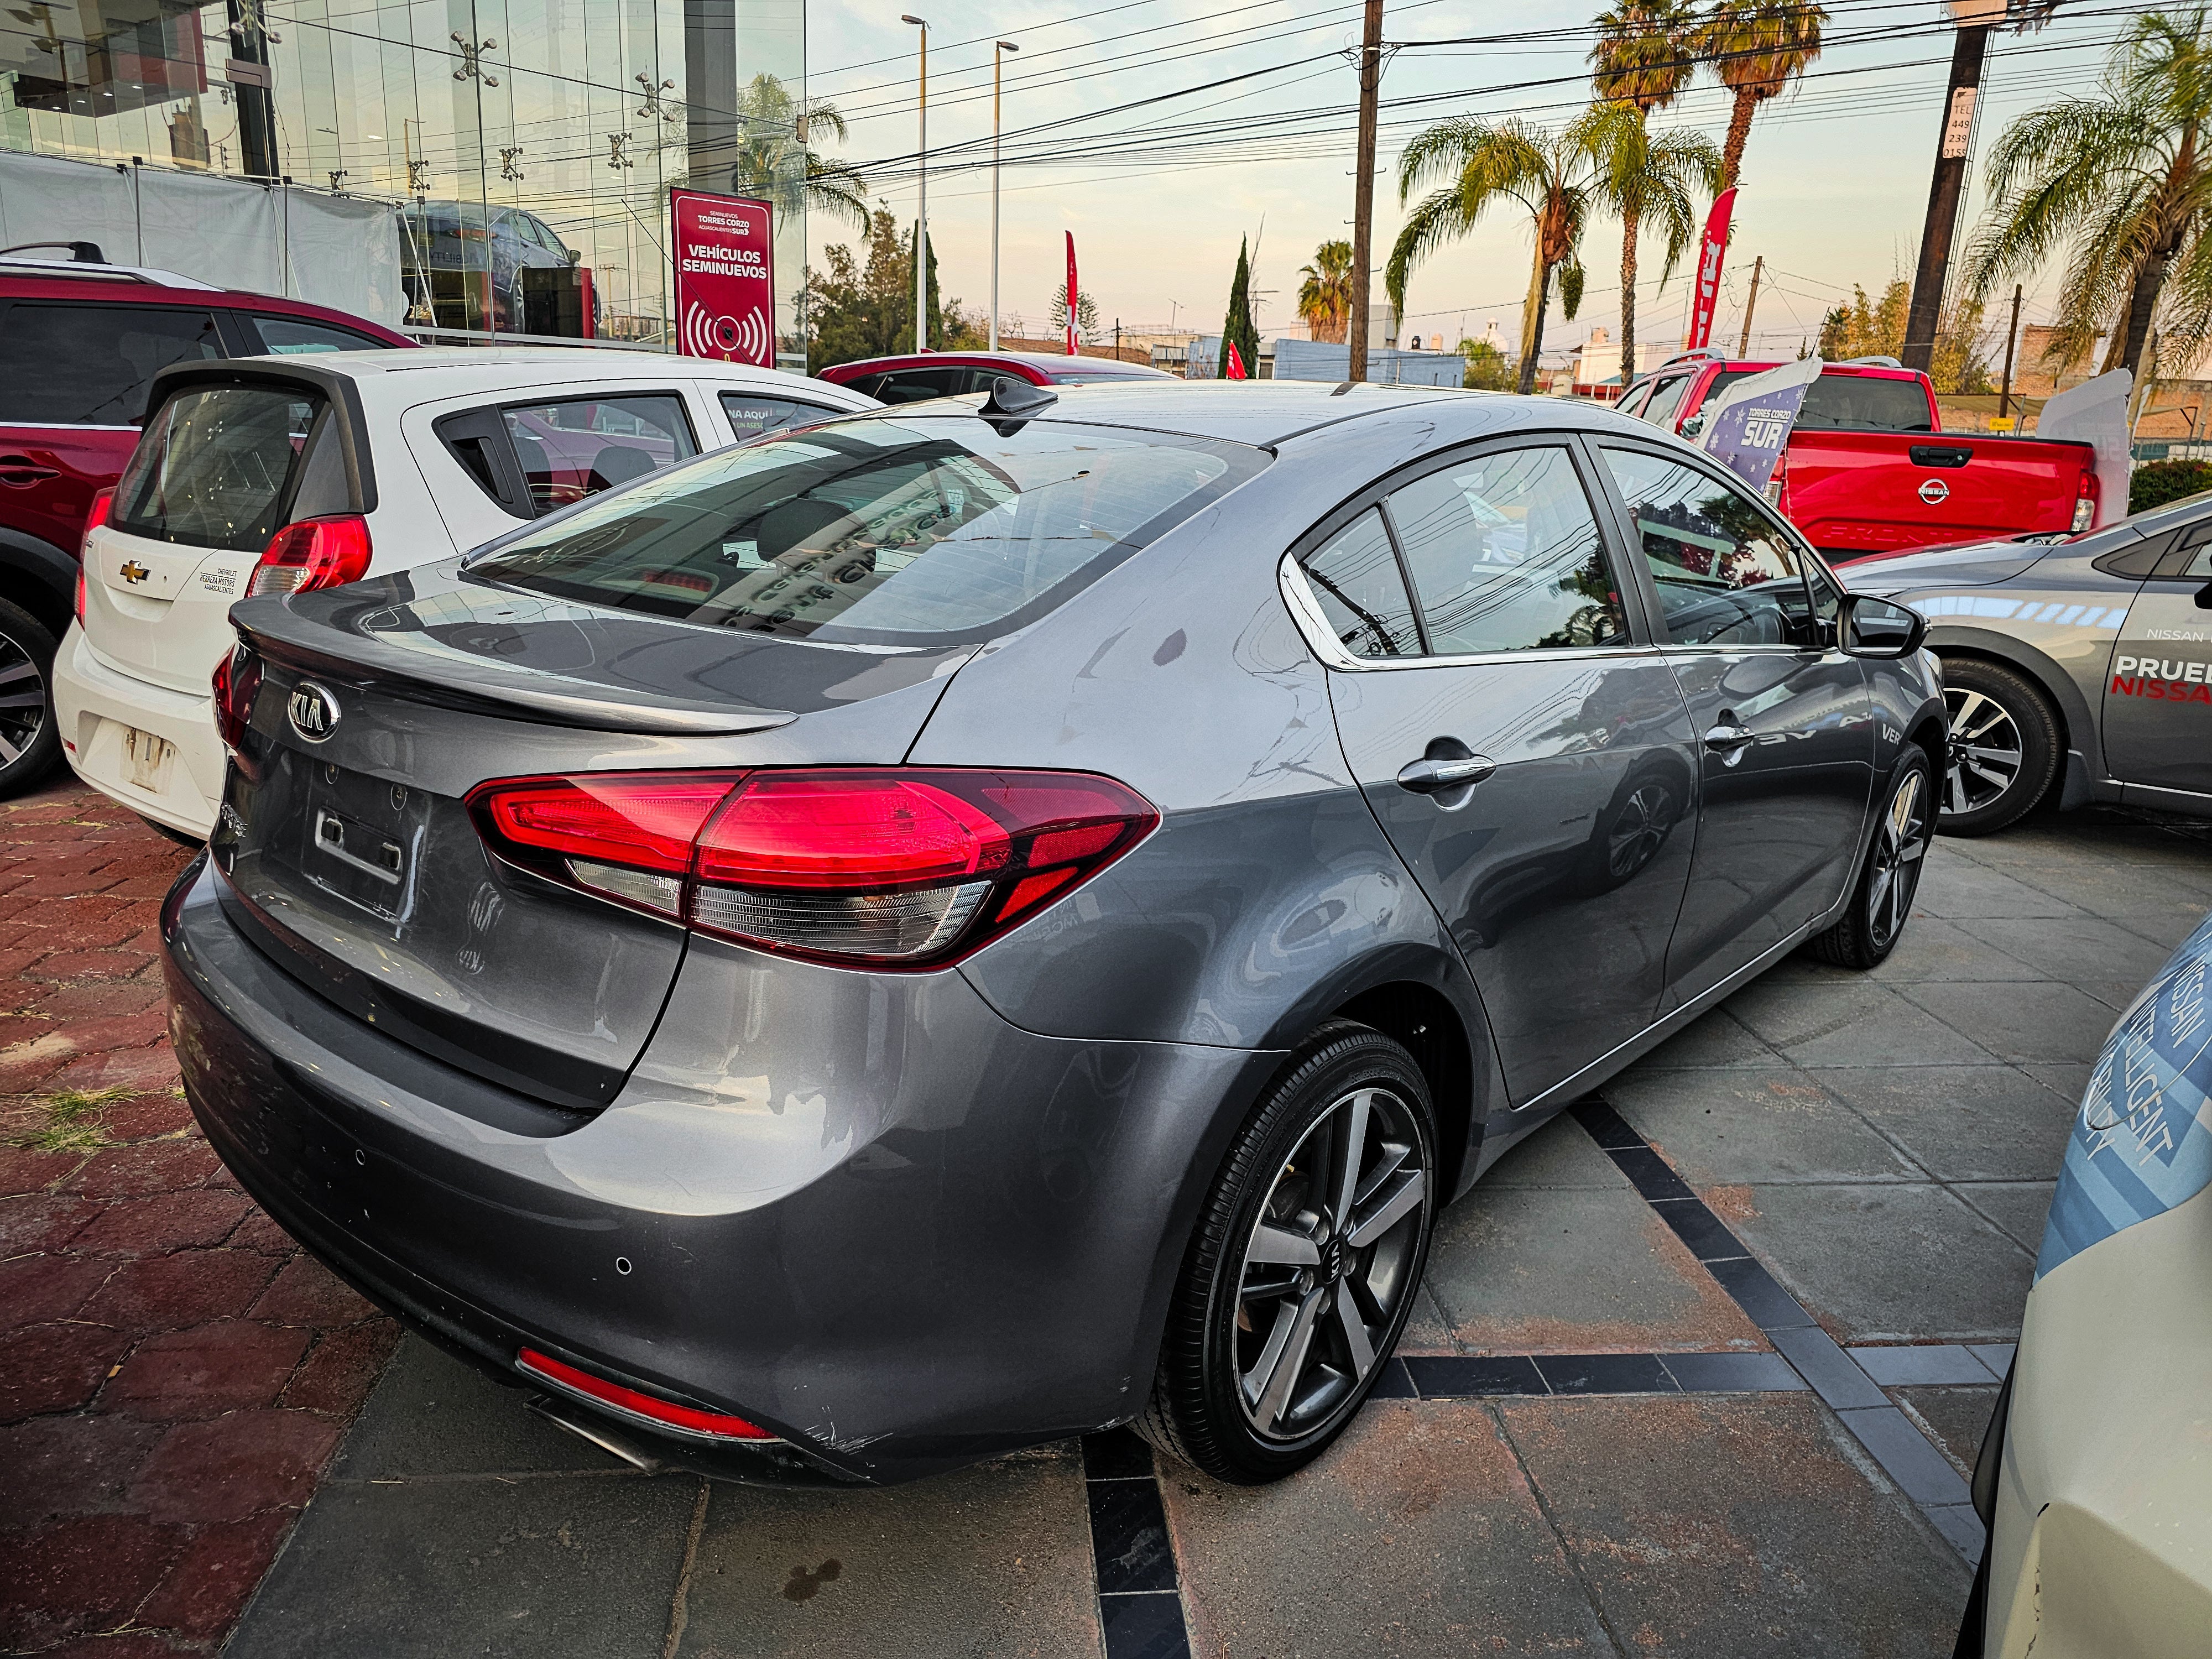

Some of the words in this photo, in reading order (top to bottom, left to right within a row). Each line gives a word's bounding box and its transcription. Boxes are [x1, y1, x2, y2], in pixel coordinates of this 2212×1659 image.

[1952, 120, 1969, 128] 449
[1949, 134, 1966, 143] 239
[698, 215, 726, 225] TORRES
[726, 219, 749, 228] CORZO
[710, 211, 738, 219] SEMINUEVOS
[688, 244, 761, 264] VEHÍCULOS
[682, 259, 767, 279] SEMINUEVOS
[1749, 408, 1771, 418] TORRES
[1771, 409, 1792, 420] CORZO
[1740, 420, 1783, 450] SUR
[217, 568, 237, 577] CHEVROLET
[200, 574, 217, 585] HERRERA
[218, 577, 235, 587] MOTORS
[204, 583, 234, 594] AGUASCALIENTES
[2147, 628, 2204, 643] NISSAN
[290, 691, 324, 731] KIA
[2171, 952, 2206, 1048] NISSAN
[2125, 993, 2174, 1167] INTELLIGENT
[1331, 1243, 1340, 1279] KIA
